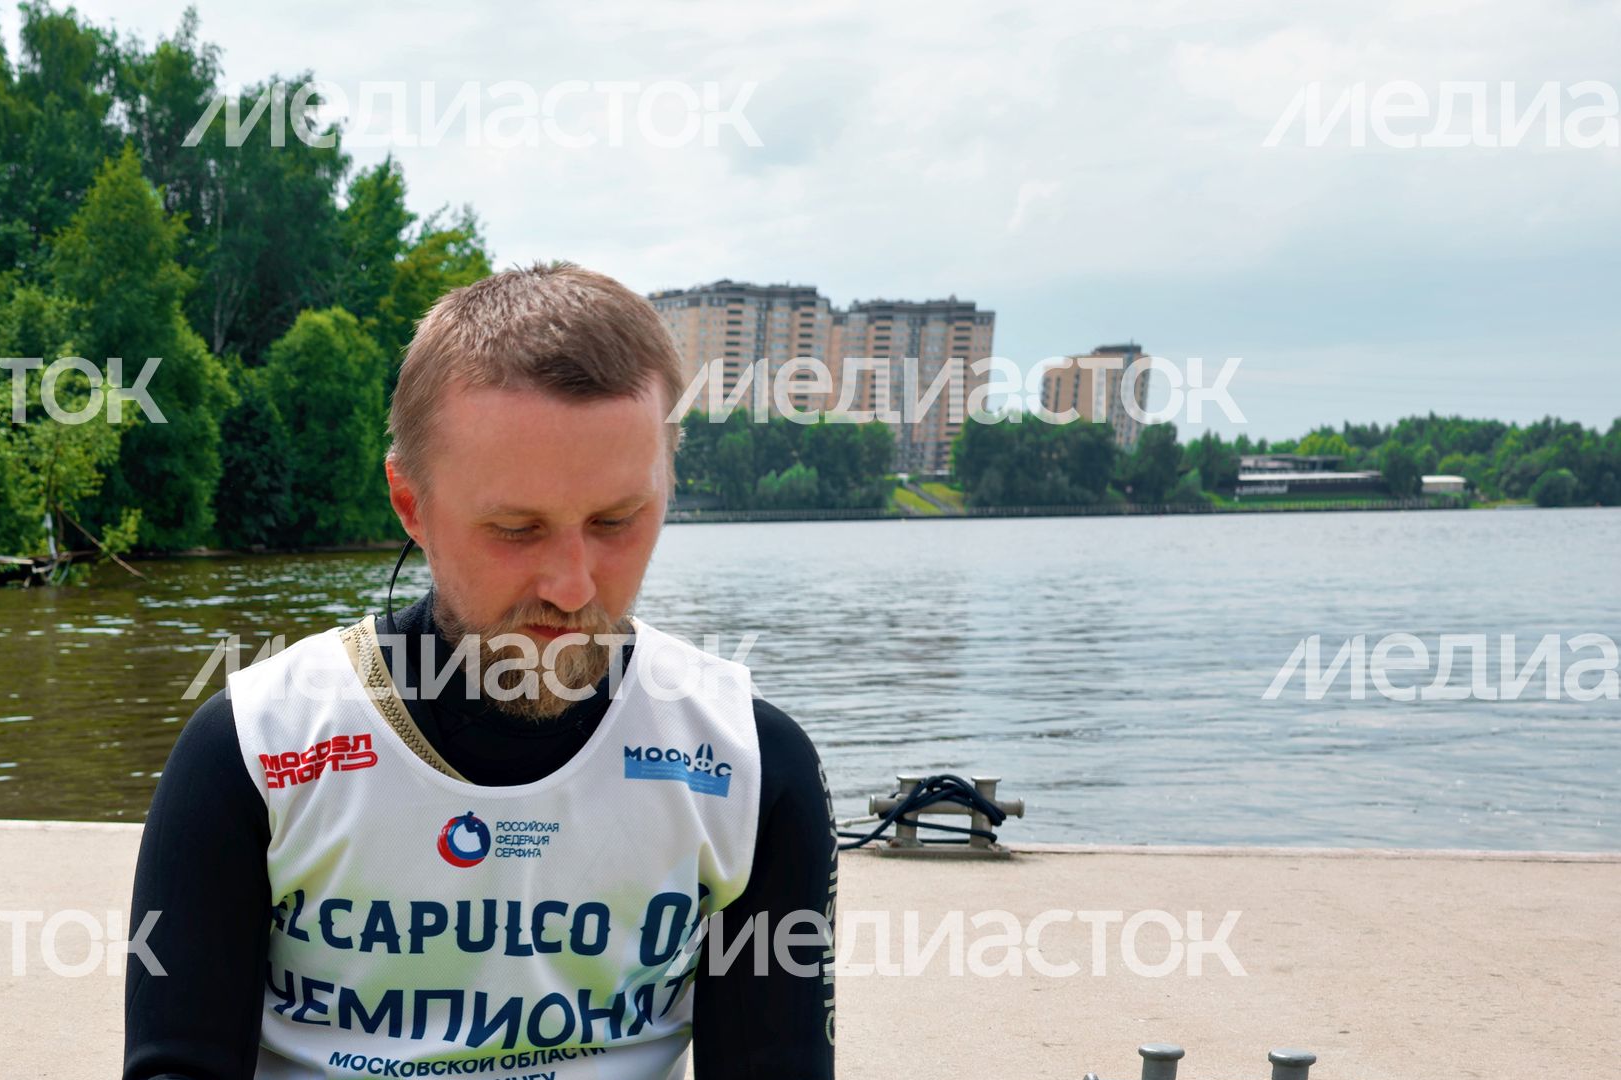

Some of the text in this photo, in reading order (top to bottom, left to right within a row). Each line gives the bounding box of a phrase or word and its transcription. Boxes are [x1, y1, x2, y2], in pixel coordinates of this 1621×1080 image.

[495, 821, 560, 833] РОССИЙСКАЯ
[495, 834, 550, 846] ФЕДЕРАЦИЯ
[495, 847, 542, 859] СЕРФИНГА
[266, 960, 697, 1050] ЧЕМПИОНАТ
[328, 1052, 495, 1078] МОСКОВСКОЙ
